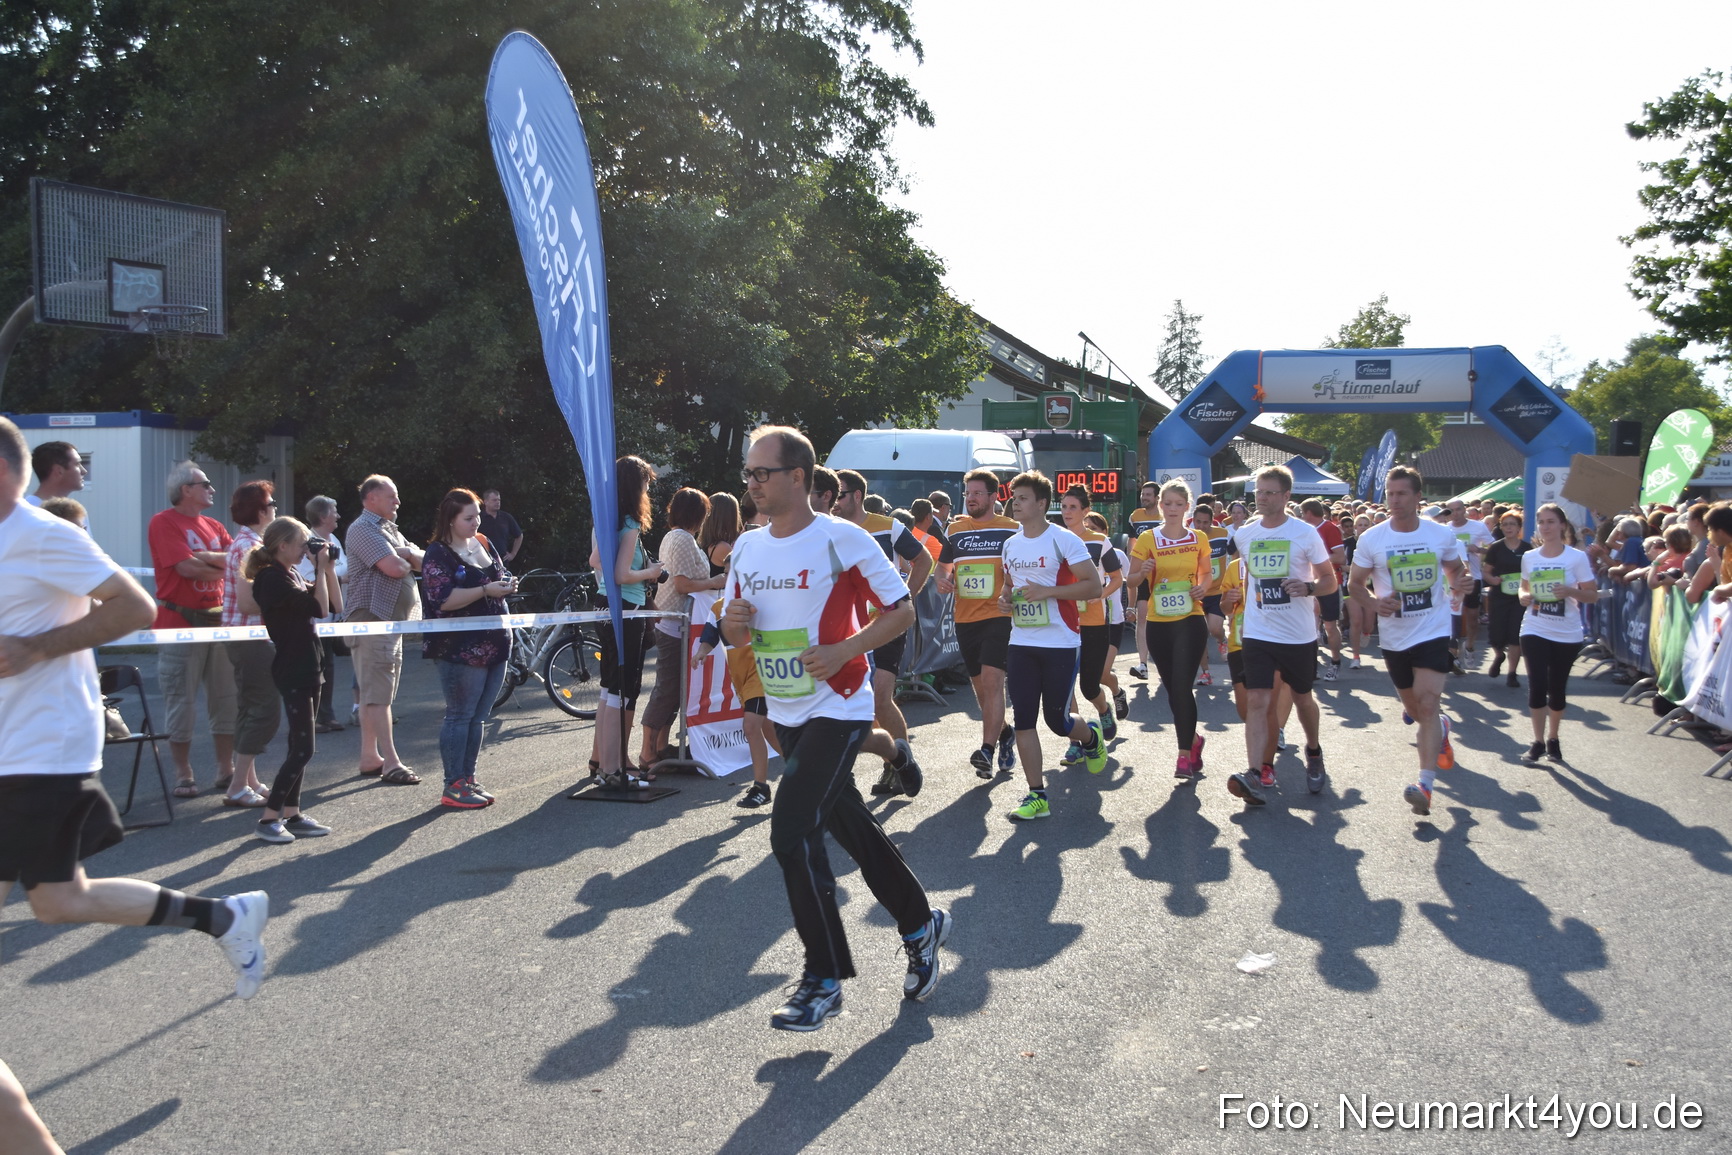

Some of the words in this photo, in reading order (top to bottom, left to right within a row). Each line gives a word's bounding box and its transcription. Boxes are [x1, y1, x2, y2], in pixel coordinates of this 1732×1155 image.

[1362, 365, 1389, 373] Fischer
[1342, 380, 1421, 394] firmenlauf
[1196, 408, 1237, 418] Fischer
[1645, 463, 1677, 493] AOK
[963, 539, 1001, 548] Fischer
[1157, 549, 1176, 557] MAX
[1178, 546, 1198, 554] BÖGL
[1008, 556, 1046, 571] Xplus1
[1253, 554, 1285, 568] 1157
[741, 569, 809, 595] Xplus1
[1396, 567, 1433, 583] 1158
[963, 577, 985, 590] 431
[1263, 587, 1282, 600] RW
[1406, 593, 1424, 606] RW
[1161, 594, 1185, 608] 883
[1014, 602, 1043, 617] 1501
[756, 656, 804, 679] 1500
